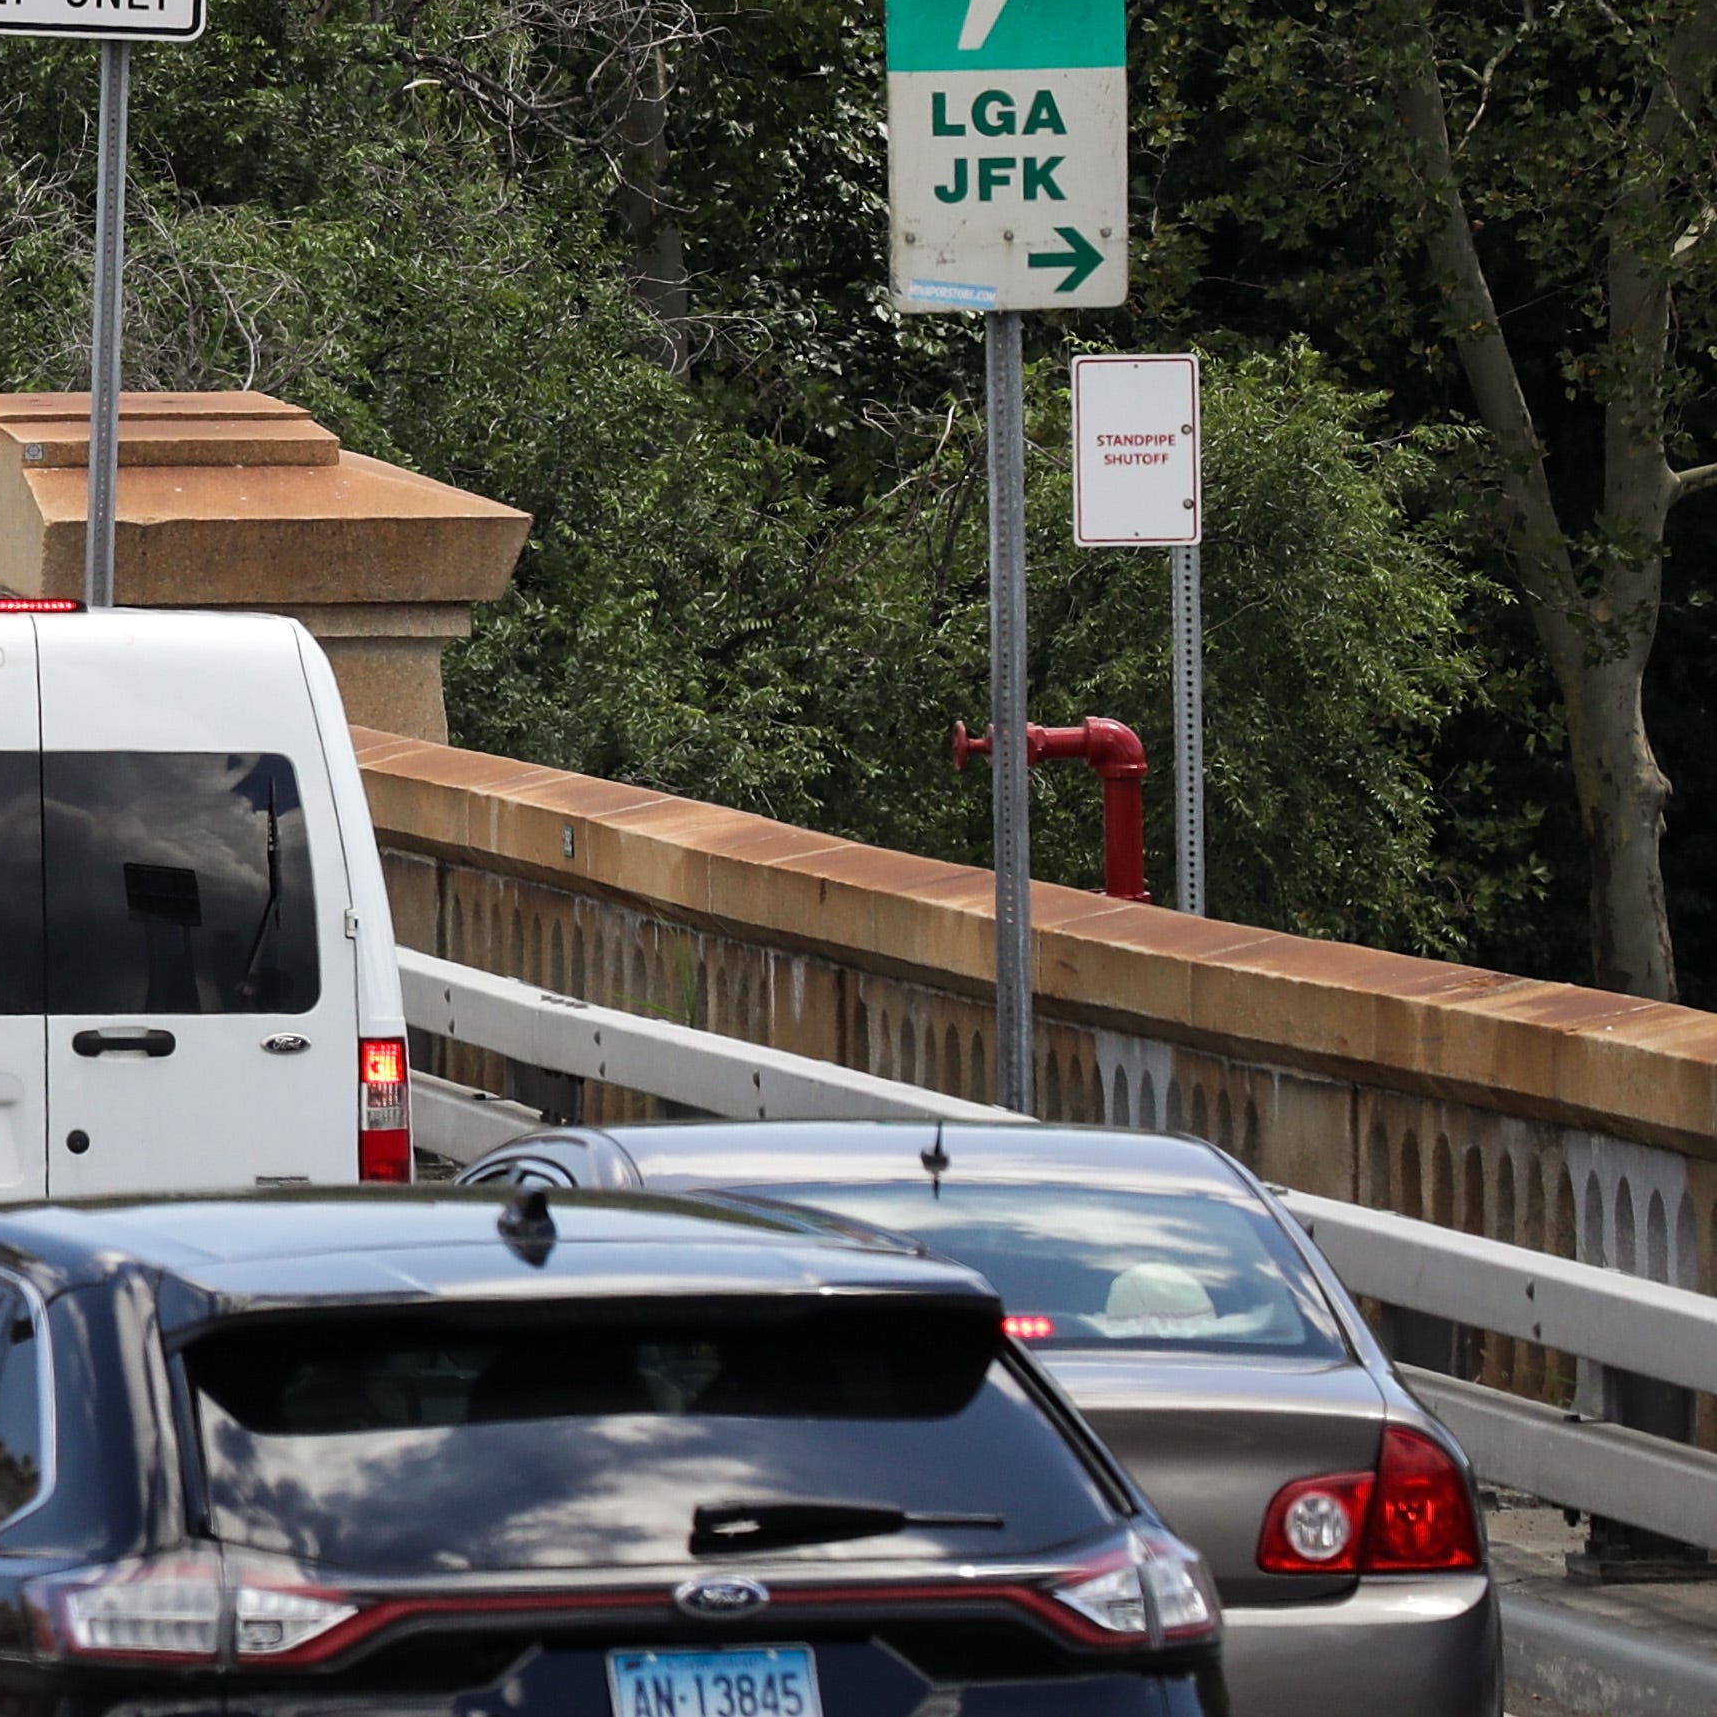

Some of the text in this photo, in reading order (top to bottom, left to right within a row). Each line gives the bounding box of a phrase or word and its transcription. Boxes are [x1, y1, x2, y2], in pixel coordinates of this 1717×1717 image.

[931, 89, 1067, 137] LGA
[934, 156, 1067, 204] JFK
[1096, 434, 1176, 447] STANDPIPE
[1104, 453, 1169, 465] SHUTOFF
